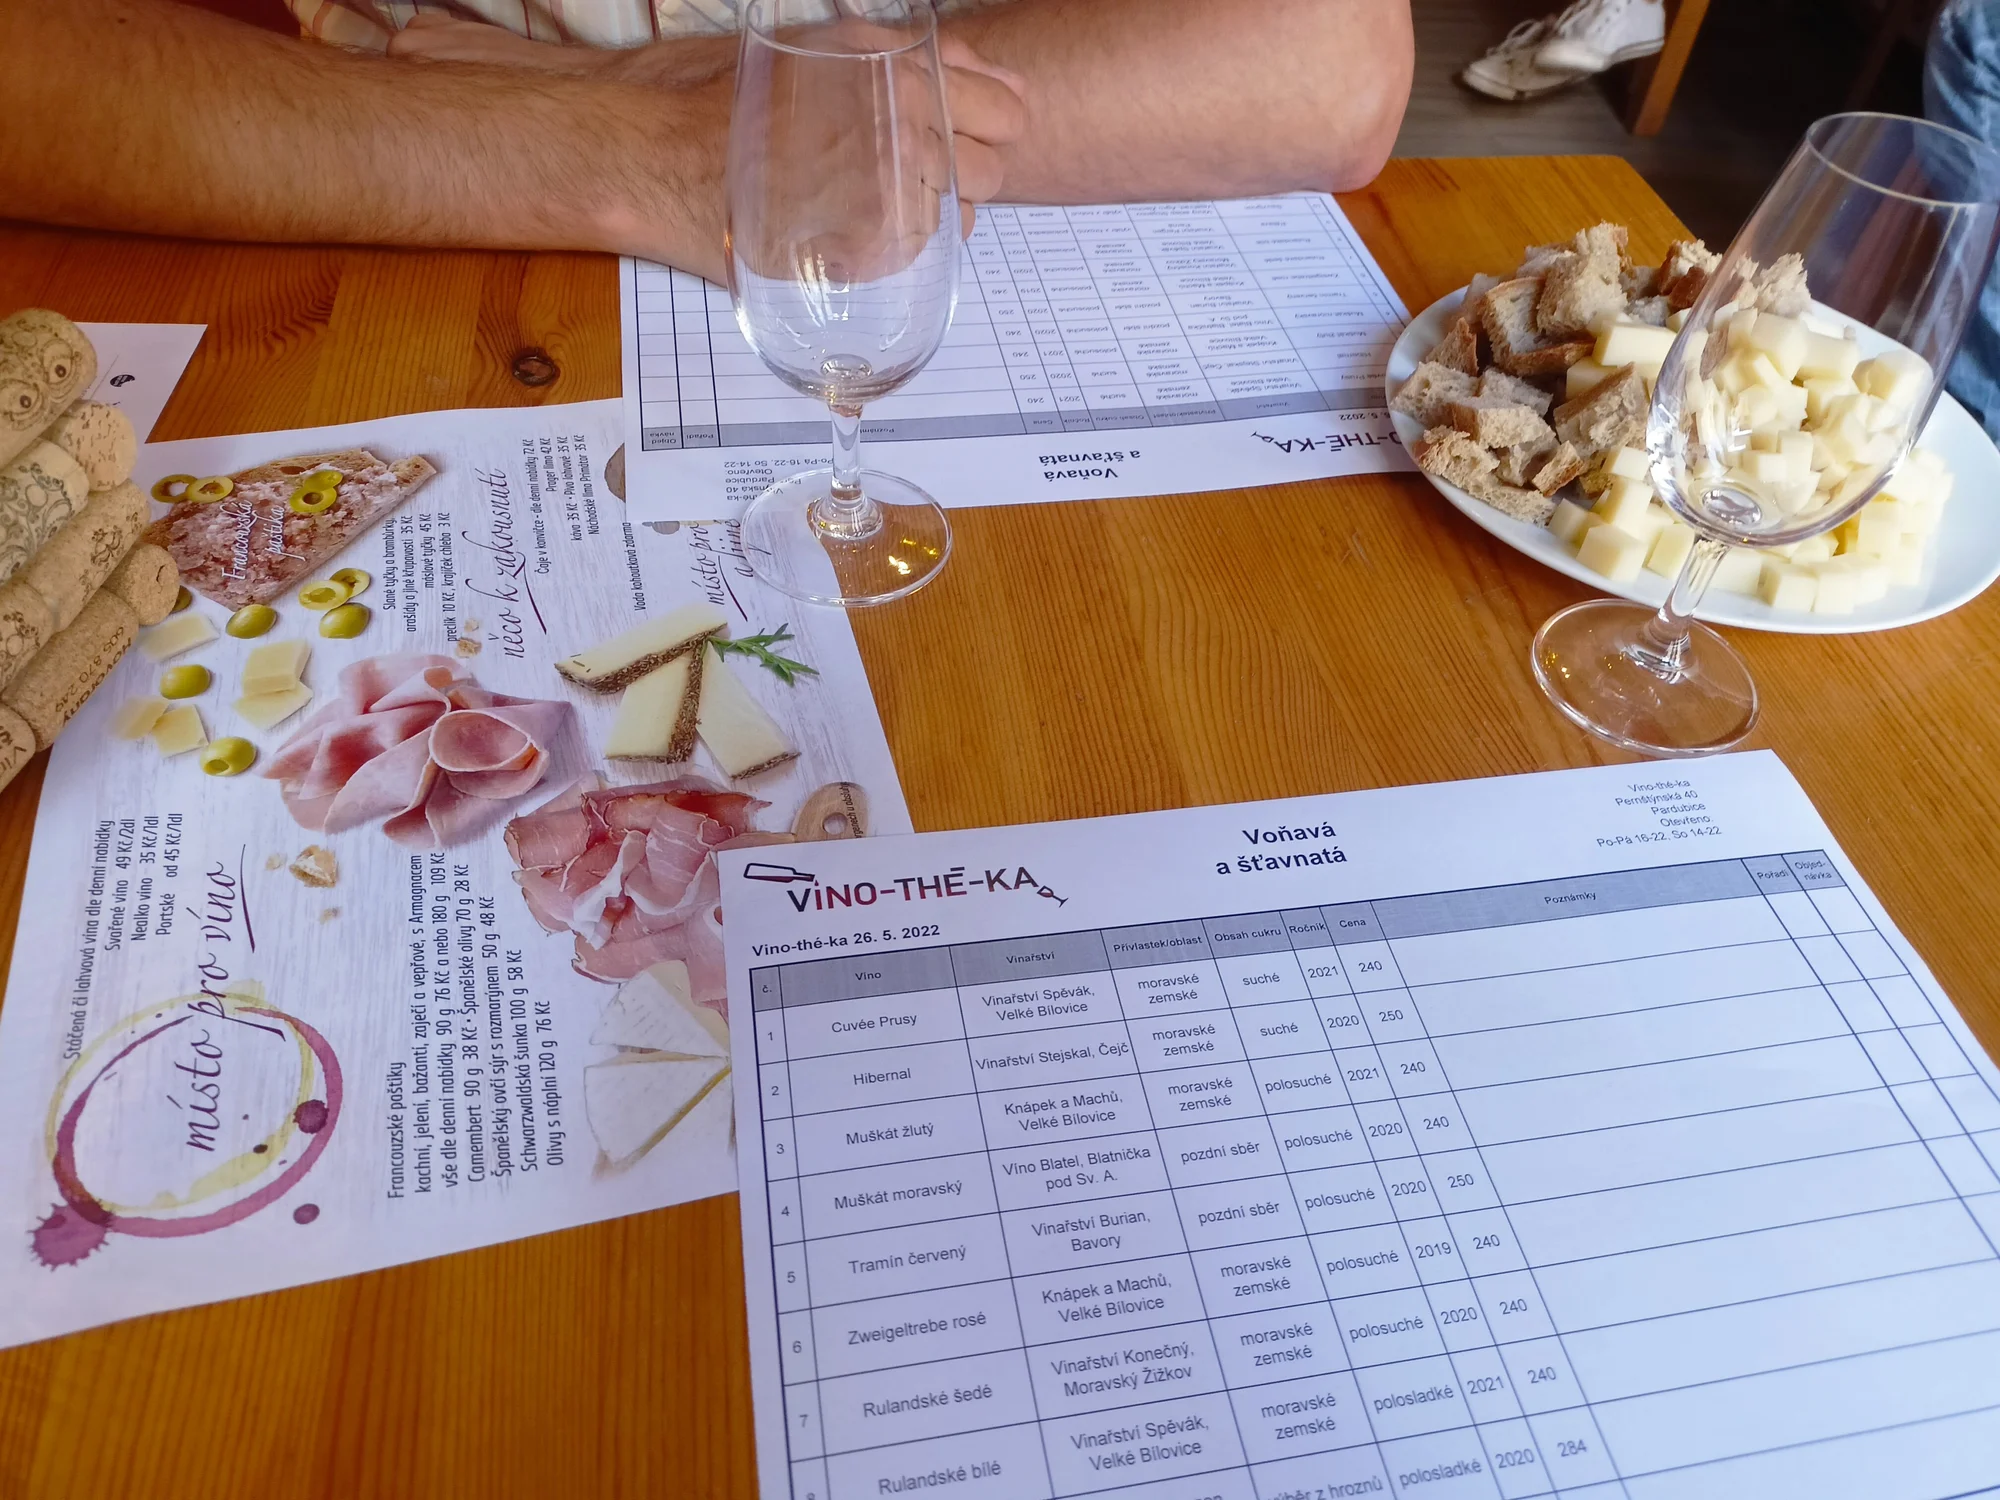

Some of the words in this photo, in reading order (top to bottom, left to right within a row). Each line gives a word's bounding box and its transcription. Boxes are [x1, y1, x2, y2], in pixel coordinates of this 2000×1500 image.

[539, 438, 551, 446] Kč
[540, 446, 552, 455] 42
[543, 455, 554, 470] limo
[545, 470, 559, 492] Prager
[400, 515, 413, 525] Kč
[400, 525, 414, 534] 35
[461, 467, 526, 580] zakousnutí
[622, 522, 636, 548] zdarma
[689, 522, 747, 553] pro
[401, 539, 417, 577] křupavosti
[383, 567, 399, 587] tyčky
[624, 550, 642, 590] kohoutková
[692, 553, 726, 605] místo
[734, 565, 754, 578] a
[402, 579, 418, 593] jiné
[465, 578, 520, 602] k
[382, 589, 396, 610] Slané
[632, 592, 646, 611] Voda
[403, 602, 419, 632] arašídy
[488, 607, 524, 658] něco
[1627, 780, 1691, 793] Vino-thé-ka
[1684, 790, 1698, 799] 40
[1650, 803, 1706, 815] Pardubice
[94, 821, 115, 862] nabídky
[1242, 822, 1336, 844] Voňavá
[1596, 835, 1633, 847] Po-Pá
[1634, 831, 1671, 843] 16-22,
[1671, 830, 1688, 839] So
[1689, 825, 1722, 837] 14-22
[115, 856, 132, 870] 49
[163, 848, 180, 862] 45
[1216, 862, 1231, 875] a
[1237, 846, 1347, 872] šťavnatá
[88, 866, 106, 896] denní
[163, 865, 178, 878] od
[1756, 869, 1789, 880] Pořadí
[1803, 871, 1832, 881] návka
[112, 880, 128, 903] víno
[408, 856, 427, 923] Armagnacem
[1544, 891, 1596, 905] Poznámky
[85, 899, 102, 916] dle
[186, 862, 236, 942] víno
[155, 894, 175, 935] Portské
[1339, 919, 1367, 928] Cena
[82, 920, 99, 944] vína
[104, 907, 125, 951] Svařené
[1214, 931, 1249, 942] Obsah
[1251, 928, 1282, 938] cukru
[1288, 922, 1326, 934] Ročník
[752, 936, 848, 956] Vino-thé-ka
[853, 931, 878, 945] 26.
[882, 929, 897, 941] 5.
[901, 924, 940, 939] 2022
[1113, 936, 1202, 952] Přívlastek/oblast
[409, 940, 429, 987] vepřové,
[1006, 951, 1055, 964] Vinařství
[1358, 960, 1383, 973] 240
[73, 948, 95, 992] lahvová
[855, 972, 882, 981] Víno
[1242, 972, 1281, 986] suché
[1307, 965, 1339, 979] 2021
[762, 984, 773, 994] č.
[1138, 974, 1199, 989] moravské
[72, 996, 88, 1007] či
[186, 953, 286, 1042] pro
[413, 992, 426, 1000] a
[982, 991, 1039, 1006] Vinařství
[1043, 986, 1094, 1001] Spěvák,
[1148, 989, 1198, 1004] zemské
[411, 1005, 431, 1039] zaječí
[995, 1007, 1034, 1021] Velké
[1037, 1002, 1088, 1017] Bílovice
[63, 1010, 86, 1059] Stáčená
[831, 1019, 875, 1033] Cuvée
[879, 1015, 917, 1028] Prusy
[767, 1031, 773, 1041] 1
[975, 1053, 1034, 1069] Vinařství
[1039, 1047, 1094, 1063] Stejskal,
[1098, 1042, 1129, 1057] Čejč
[412, 1044, 429, 1094] bažantí,
[854, 1068, 911, 1085] Hibernal
[166, 1029, 223, 1152] místo
[387, 1062, 407, 1109] paštiky
[771, 1085, 780, 1096] 2
[1265, 1074, 1332, 1094] polosuché
[413, 1099, 434, 1139] jelení,
[1369, 1123, 1403, 1137] 2020
[846, 1128, 899, 1145] Muškát
[902, 1123, 933, 1139] žlutý
[387, 1114, 404, 1198] Francouzské
[1002, 1162, 1037, 1176] Víno
[1040, 1155, 1083, 1171] Blatel,
[1087, 1148, 1151, 1165] Blatnička
[1181, 1145, 1226, 1165] pozdní
[1230, 1141, 1260, 1156] sběr
[414, 1145, 432, 1193] kachní,
[1046, 1175, 1071, 1192] pod
[1074, 1172, 1099, 1186] Sv.
[1103, 1169, 1118, 1182] A.
[848, 1255, 903, 1273] Tramín
[908, 1245, 966, 1265] červený
[848, 1319, 948, 1345] Zweigeltrebe
[953, 1312, 986, 1328] rosé
[1051, 1352, 1119, 1375] Vinařství
[1123, 1342, 1194, 1364] Konečný,
[1064, 1372, 1137, 1396] Moravský
[1142, 1366, 1191, 1384] Žižkov
[863, 1391, 949, 1417] Rulandské
[954, 1384, 992, 1403] šedé
[1495, 1448, 1535, 1469] 2020
[1399, 1459, 1482, 1490] polosladké
